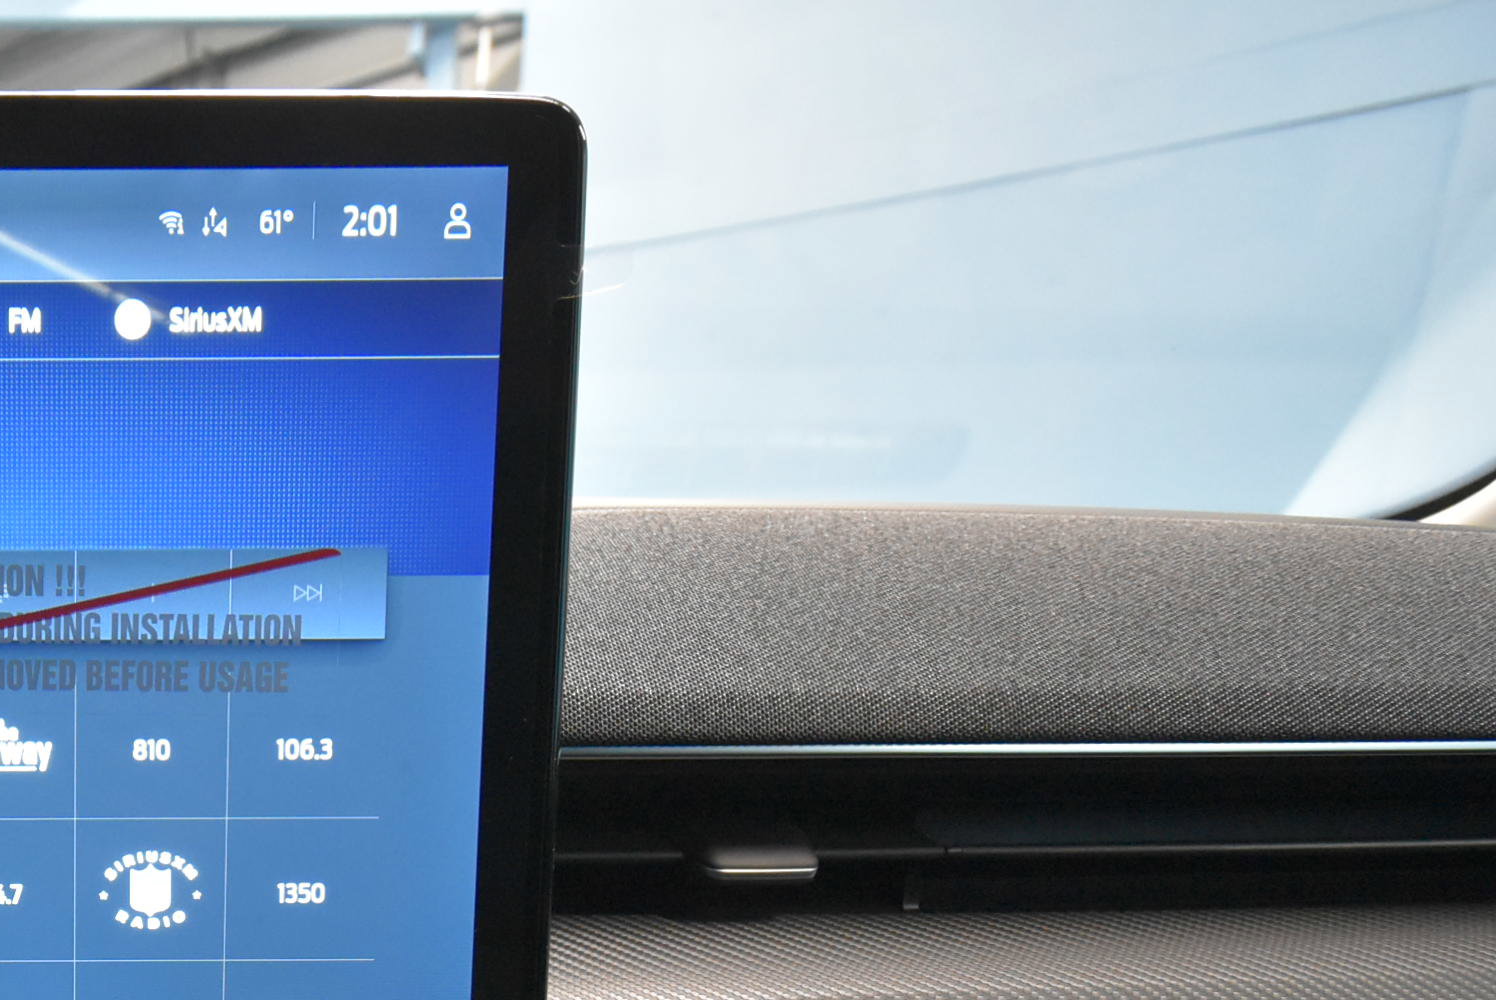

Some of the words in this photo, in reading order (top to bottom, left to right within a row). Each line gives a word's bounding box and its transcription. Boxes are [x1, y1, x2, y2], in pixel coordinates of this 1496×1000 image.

[259, 208, 294, 235] 61°
[342, 204, 398, 237] 2:01
[8, 307, 42, 334] FM
[168, 306, 263, 333] SiriusXM
[55, 564, 87, 597] !!!
[111, 612, 302, 646] INSTALLATION
[86, 659, 189, 692] BEFORE
[199, 660, 289, 692] USAGE
[132, 738, 171, 761] 810
[276, 738, 333, 760] 106.3
[277, 882, 325, 904] 1350
[114, 909, 187, 930] RADIO
